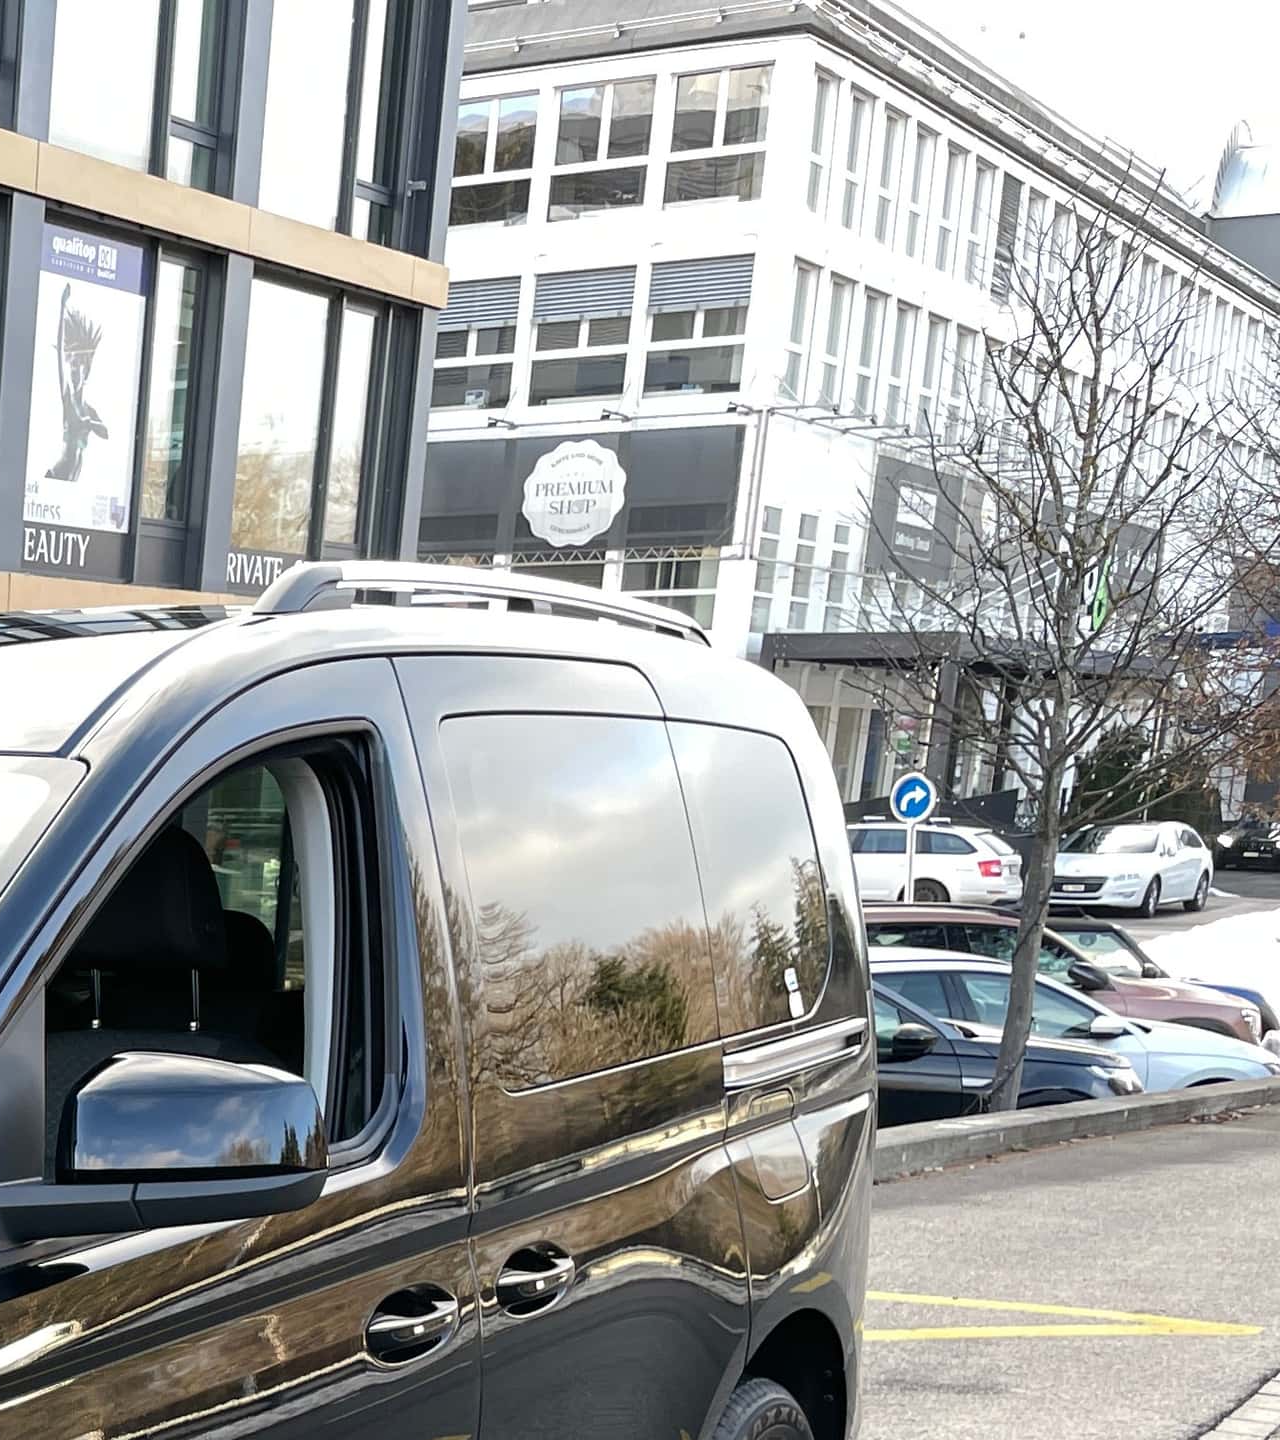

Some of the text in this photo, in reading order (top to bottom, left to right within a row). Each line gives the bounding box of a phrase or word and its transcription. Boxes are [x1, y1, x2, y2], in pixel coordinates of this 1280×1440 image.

[52, 236, 97, 263] qualitop
[535, 480, 613, 497] PREMIUM
[549, 499, 597, 515] SHOP
[24, 527, 90, 567] EAUTY
